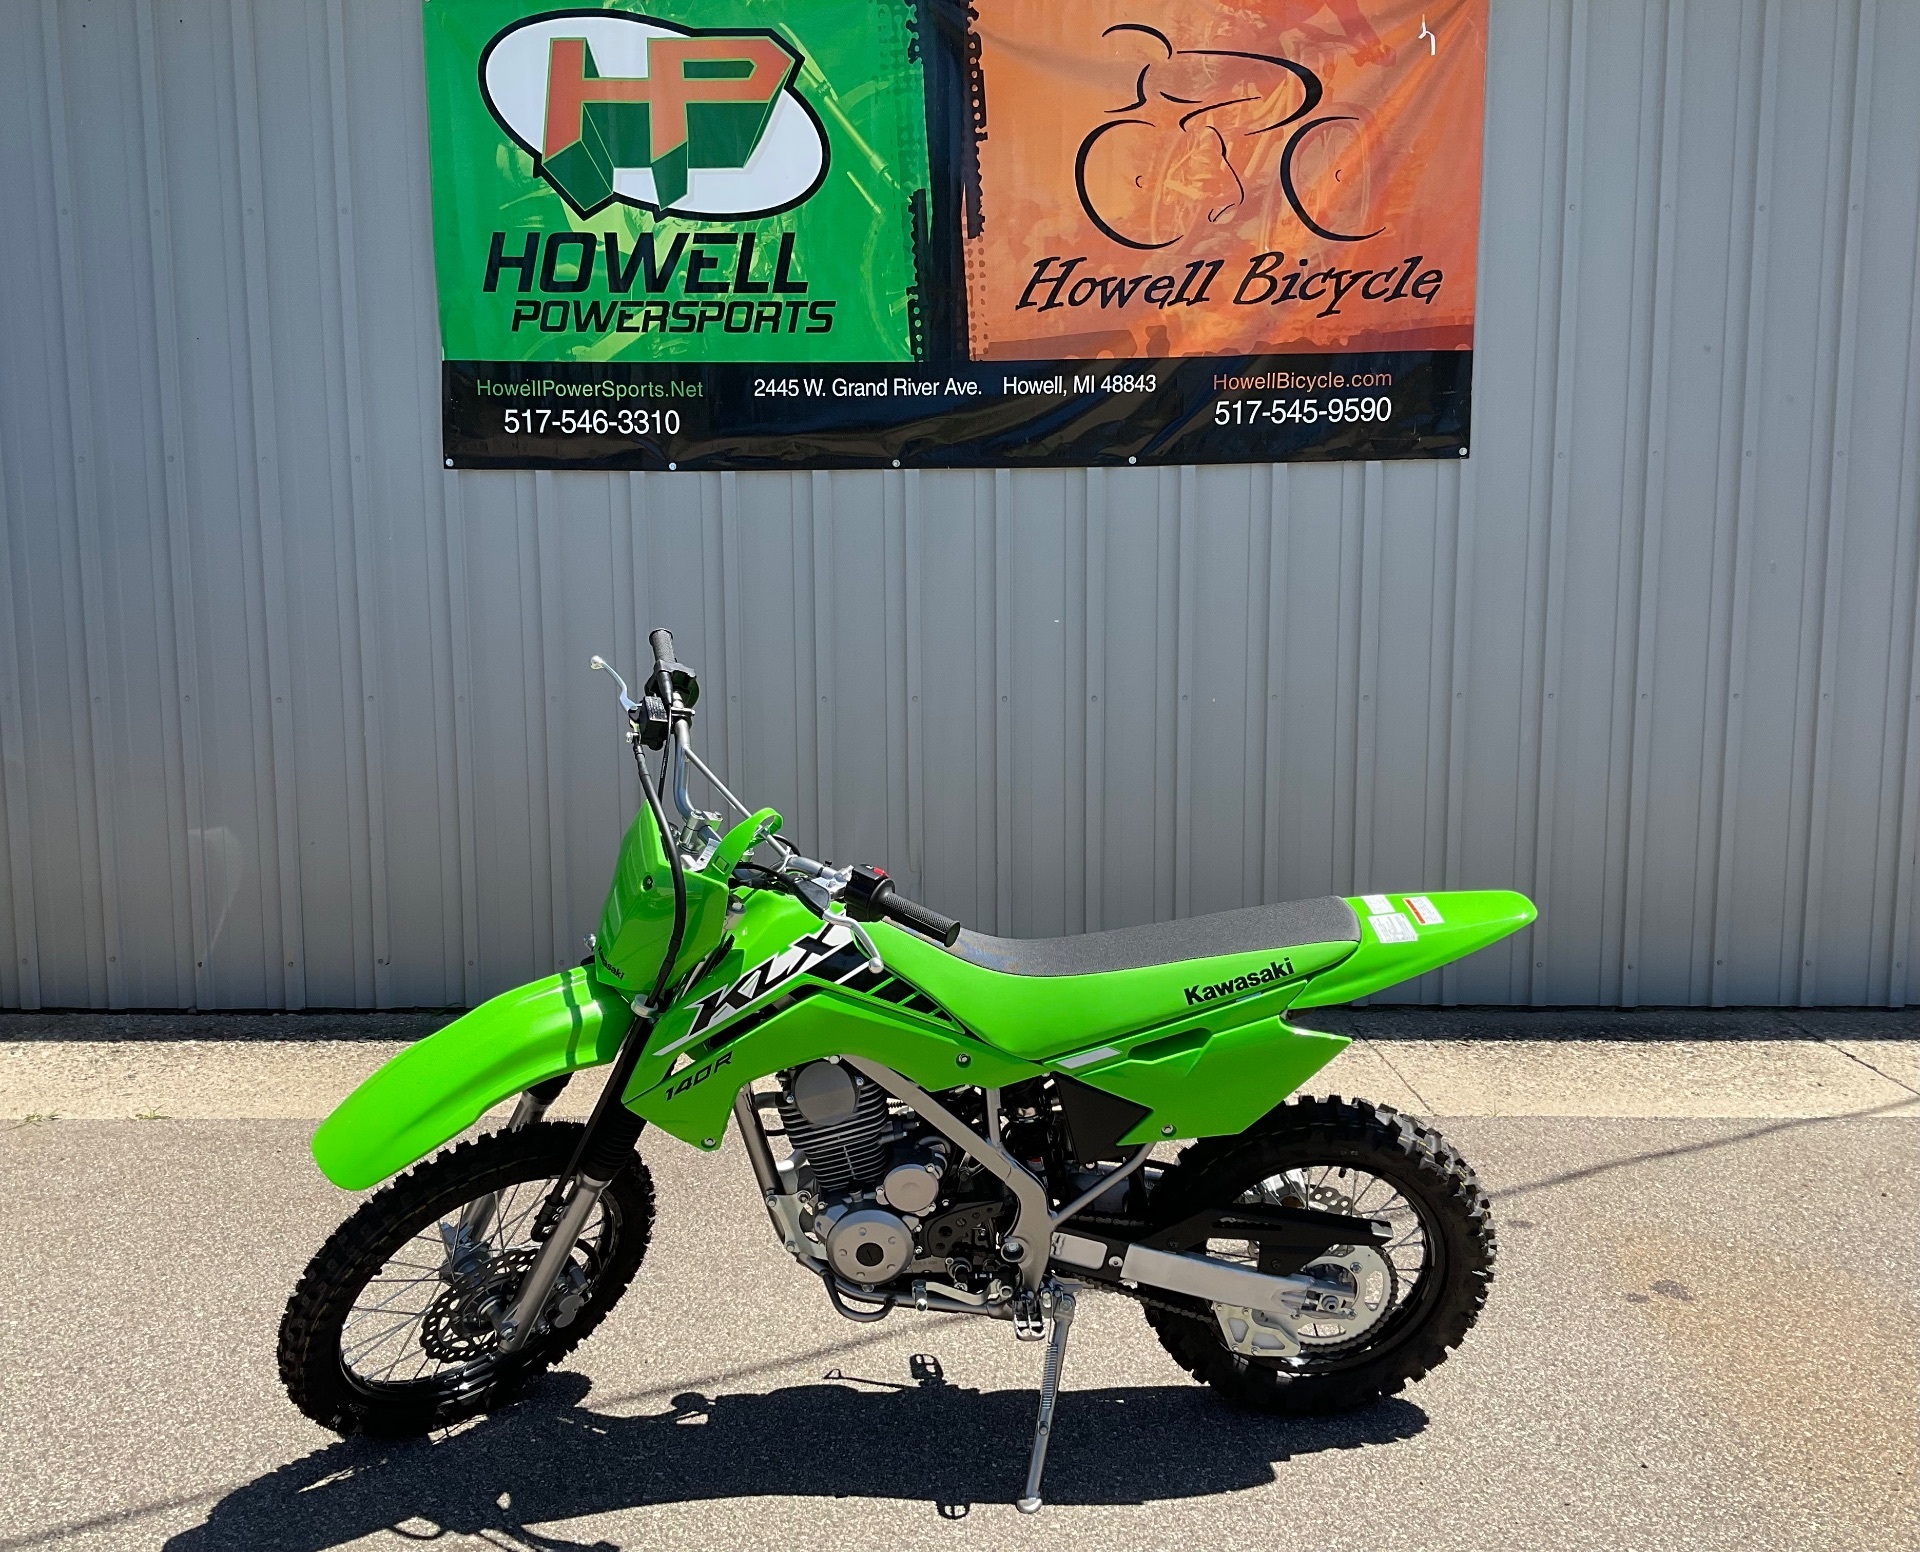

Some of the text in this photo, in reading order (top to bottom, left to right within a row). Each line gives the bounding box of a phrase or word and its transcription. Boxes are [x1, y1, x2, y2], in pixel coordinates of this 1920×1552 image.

[542, 36, 795, 209] HP
[483, 231, 809, 293] HOWELL
[1014, 251, 1444, 319] Howell Bicycle
[511, 300, 837, 334] POWERSPORTS
[477, 379, 704, 401] HowellPowerSports.Net
[753, 377, 983, 397] 2445 W. Grand River Ave.
[1002, 374, 1157, 397] Howell, MI 48843
[1212, 371, 1393, 393] HowellBicycle.com
[503, 409, 680, 435] 517-546-3310
[1213, 397, 1392, 425] 517-545-9590
[688, 913, 845, 1037] KLX
[1183, 957, 1295, 1005] Kawasaki
[665, 1051, 733, 1102] 140R
